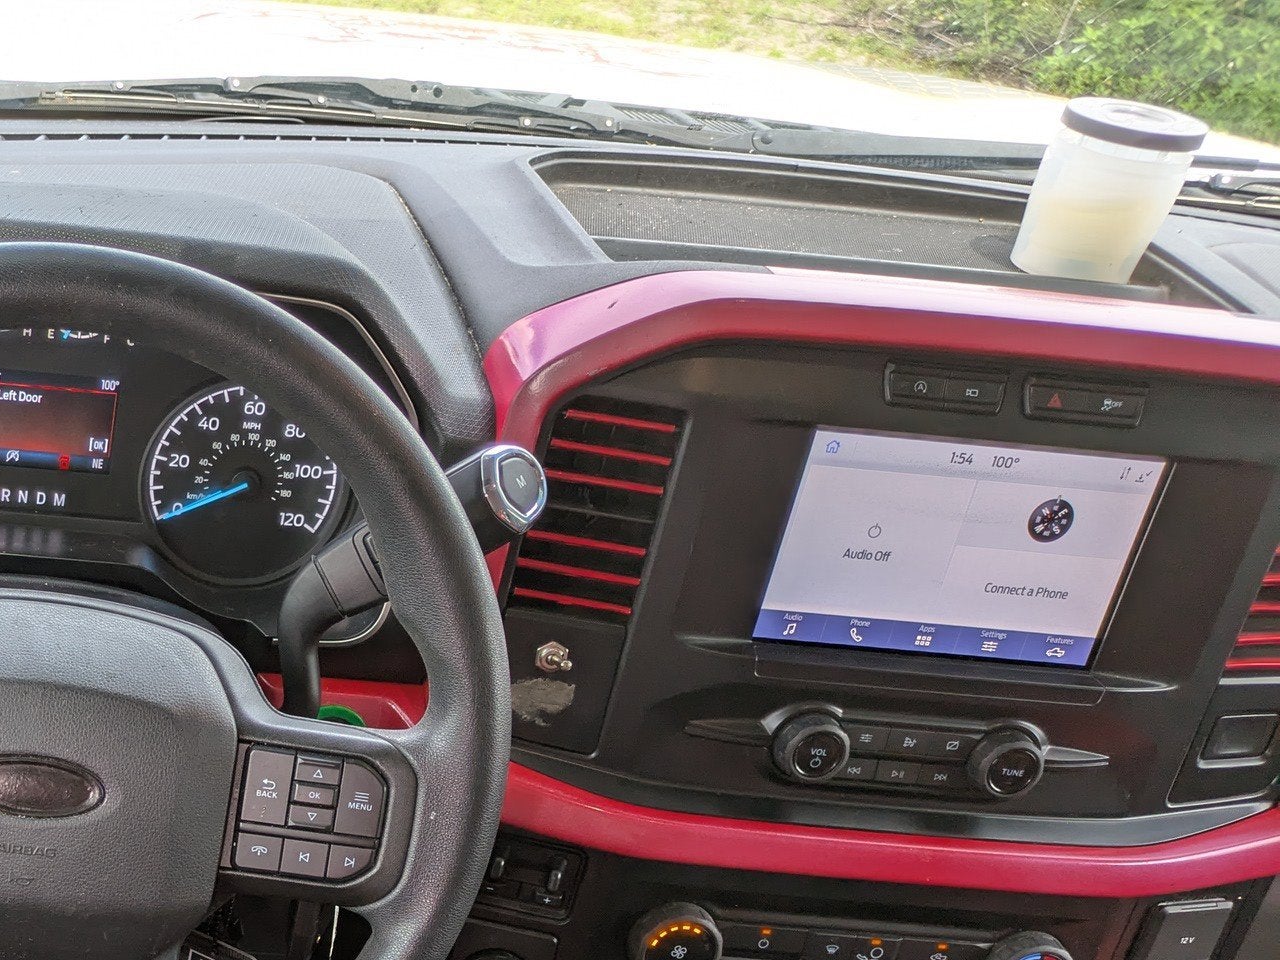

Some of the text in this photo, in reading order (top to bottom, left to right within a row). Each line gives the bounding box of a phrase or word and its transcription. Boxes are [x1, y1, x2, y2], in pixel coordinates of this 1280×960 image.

[47, 329, 55, 339] E
[101, 379, 120, 391] 100°
[18, 392, 42, 403] Door
[244, 402, 266, 416] 60
[197, 417, 219, 431] 40
[243, 421, 261, 430] MPH
[248, 433, 260, 441] 100
[212, 442, 221, 450] 60
[265, 439, 276, 447] 120
[92, 458, 103, 469] NE
[169, 454, 190, 468] 20
[199, 458, 208, 466] 40
[950, 452, 1020, 468] 1:54 100°
[295, 464, 322, 479] 100
[194, 476, 204, 484] 20
[1, 488, 11, 502] R
[18, 490, 28, 504] N
[36, 492, 46, 505] D
[53, 493, 66, 507] M
[280, 490, 291, 498] 180
[279, 512, 305, 527] 120
[842, 548, 891, 562] Audio Off
[984, 582, 1068, 599] Connect a Phone
[783, 613, 803, 622] Audio
[849, 618, 871, 627] Phone
[918, 625, 935, 634] Apps
[980, 630, 1007, 640] Settings
[1045, 636, 1074, 645] Features
[811, 748, 827, 757] VOL
[1002, 768, 1025, 777] TUNE
[256, 790, 278, 799] BACK
[309, 791, 321, 799] OK
[347, 802, 373, 812] MENU
